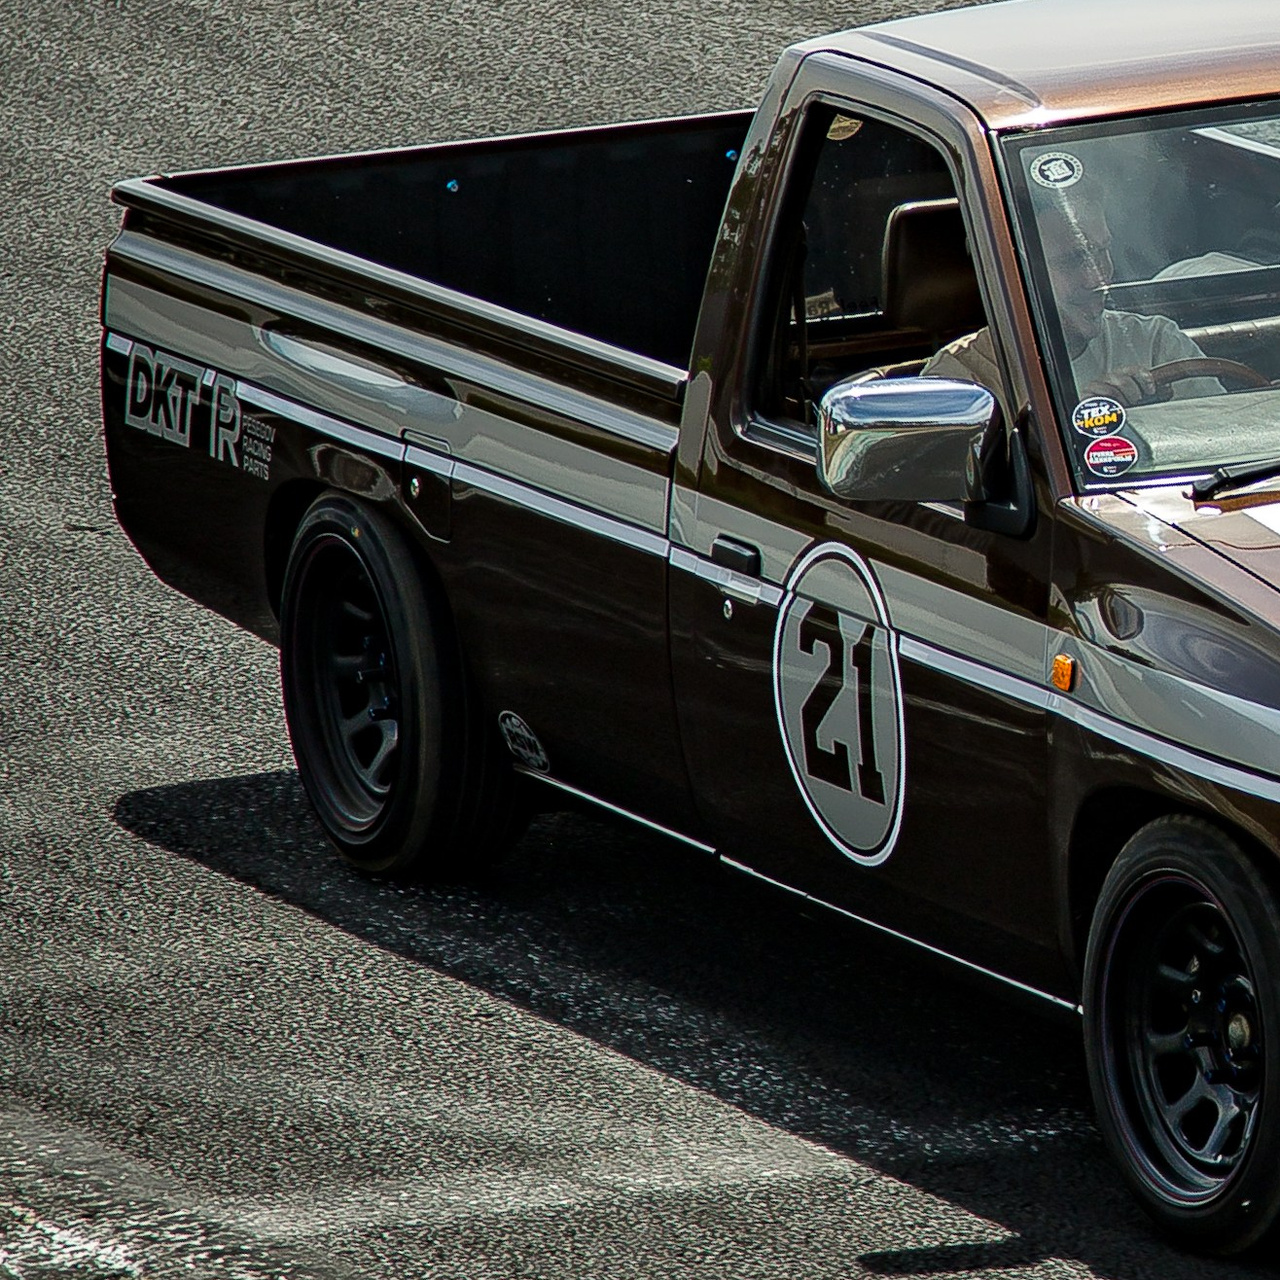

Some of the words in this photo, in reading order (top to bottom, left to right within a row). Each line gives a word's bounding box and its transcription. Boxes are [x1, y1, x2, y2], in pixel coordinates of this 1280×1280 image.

[125, 342, 205, 448] DKT
[242, 435, 272, 462] RACING
[242, 455, 270, 481] PARTS
[797, 602, 887, 806] 21
